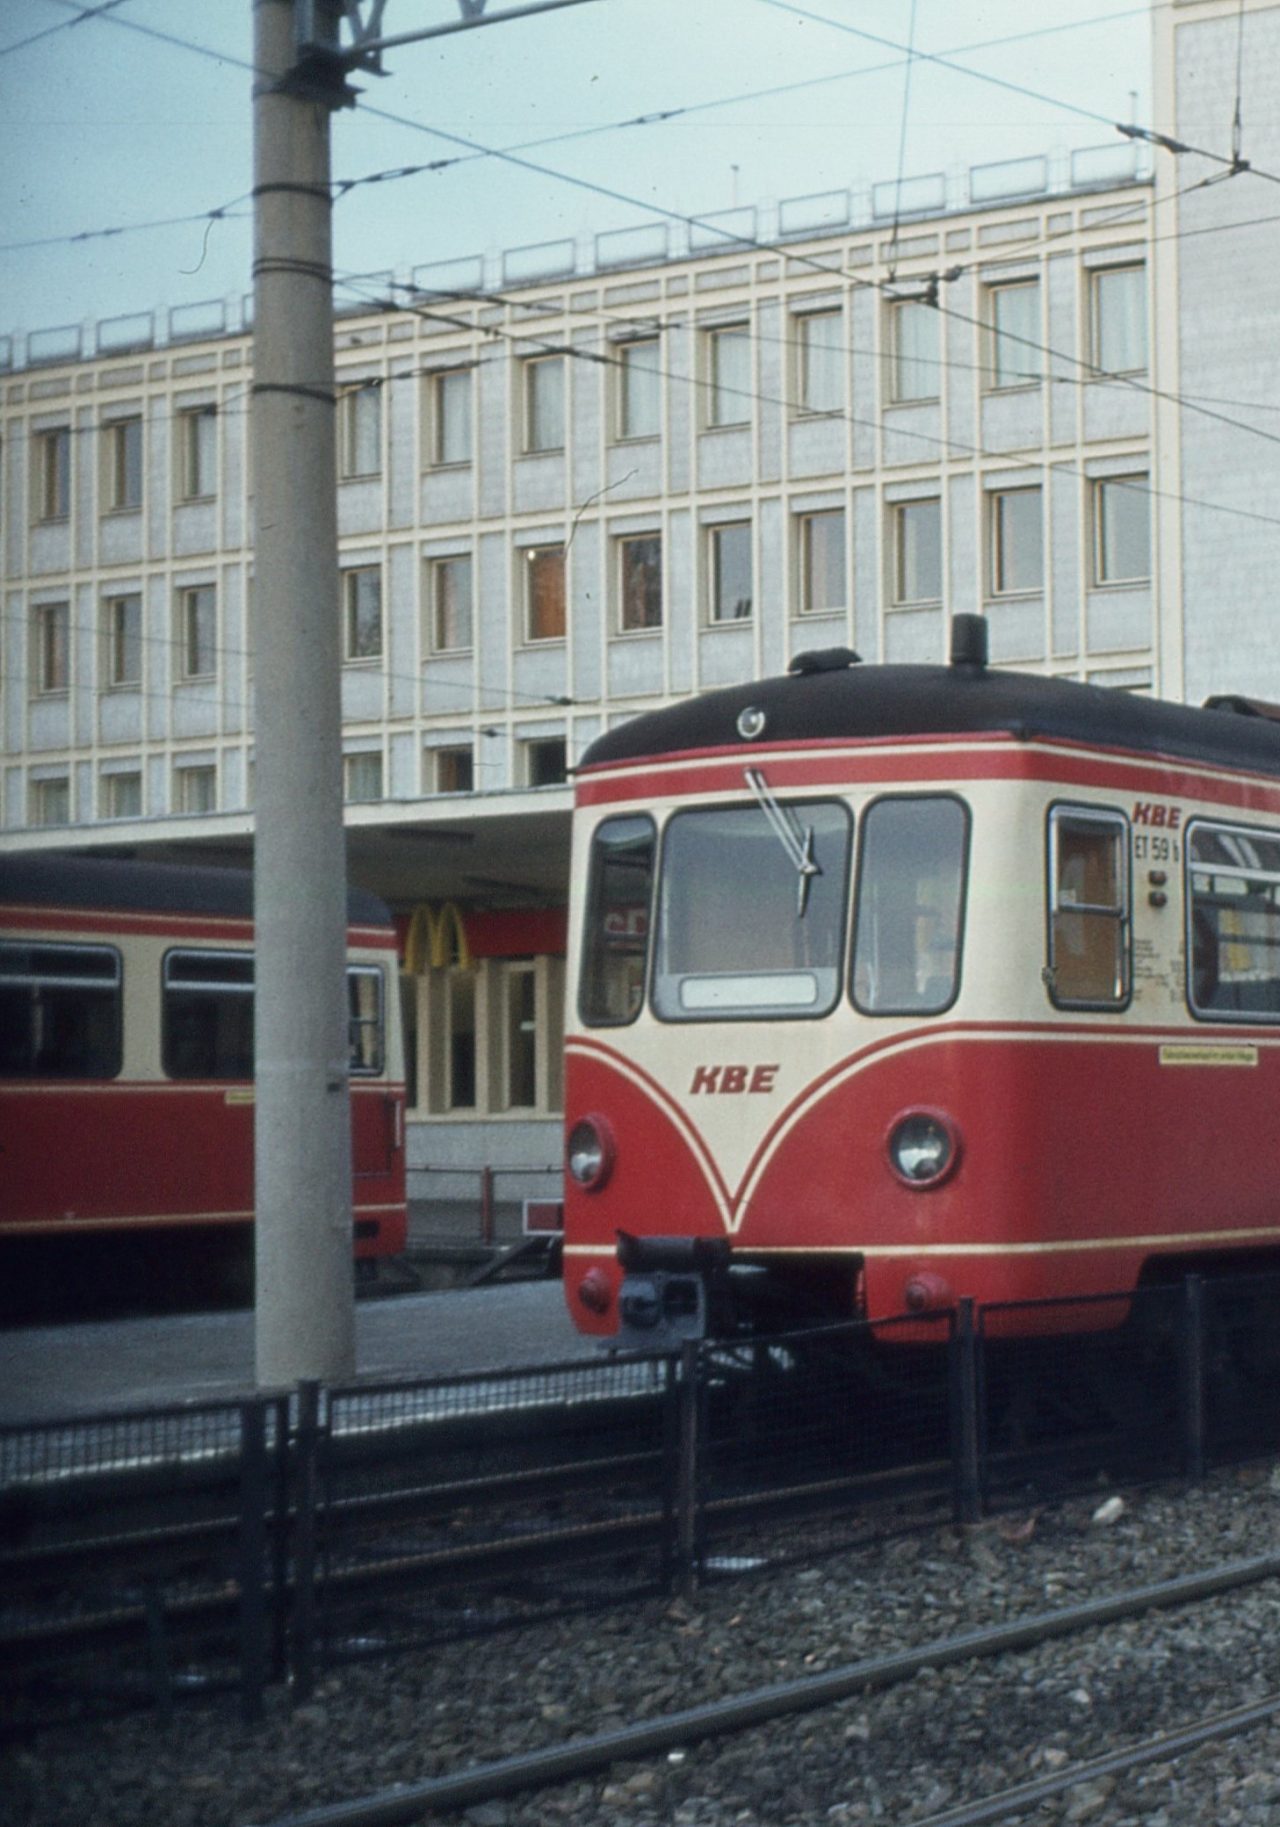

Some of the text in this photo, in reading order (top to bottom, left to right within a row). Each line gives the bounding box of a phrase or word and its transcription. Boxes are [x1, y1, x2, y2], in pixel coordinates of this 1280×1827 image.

[1131, 800, 1182, 829] KBE
[1135, 835, 1148, 859] ET
[1152, 836, 1169, 861] 59
[689, 1064, 780, 1094] KBE
